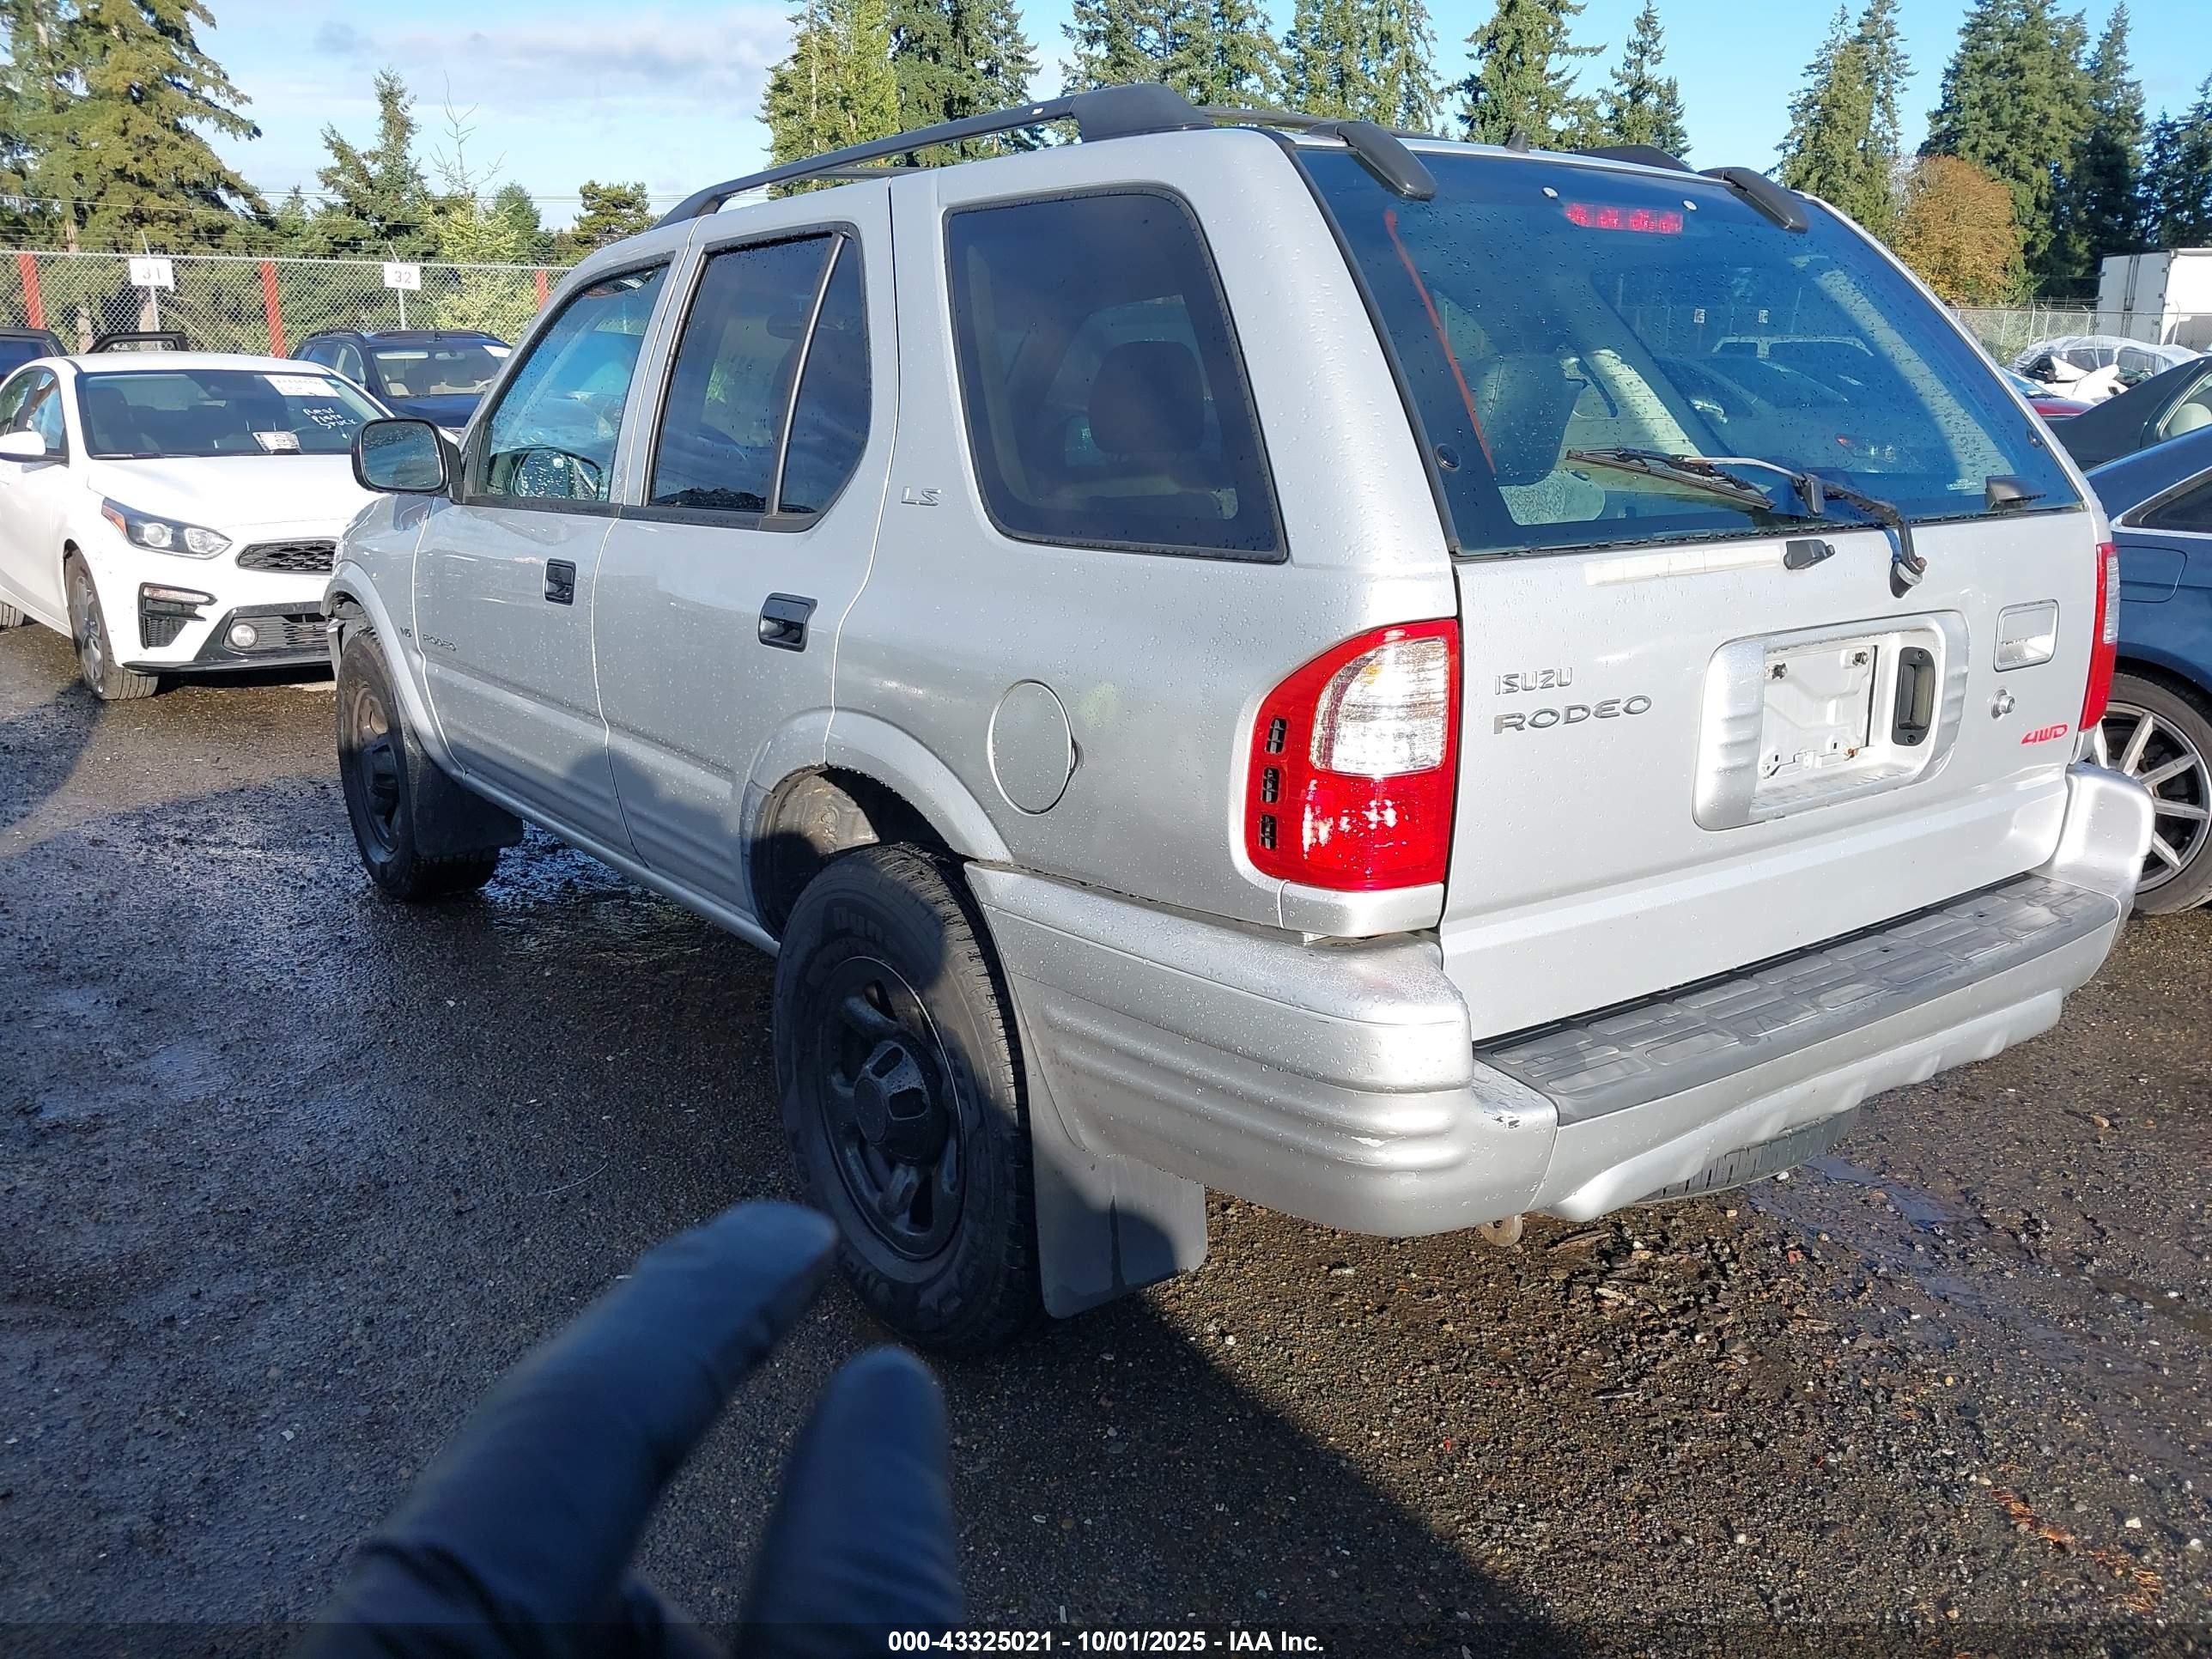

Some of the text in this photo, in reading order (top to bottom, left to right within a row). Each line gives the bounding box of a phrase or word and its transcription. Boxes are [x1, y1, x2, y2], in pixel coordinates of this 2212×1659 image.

[142, 266, 161, 281] 31
[394, 270, 412, 284] 32
[900, 486, 942, 507] LS
[1493, 666, 1573, 696] ISUZU
[1492, 694, 1652, 735] RODEO
[2021, 722, 2069, 744] 4WD
